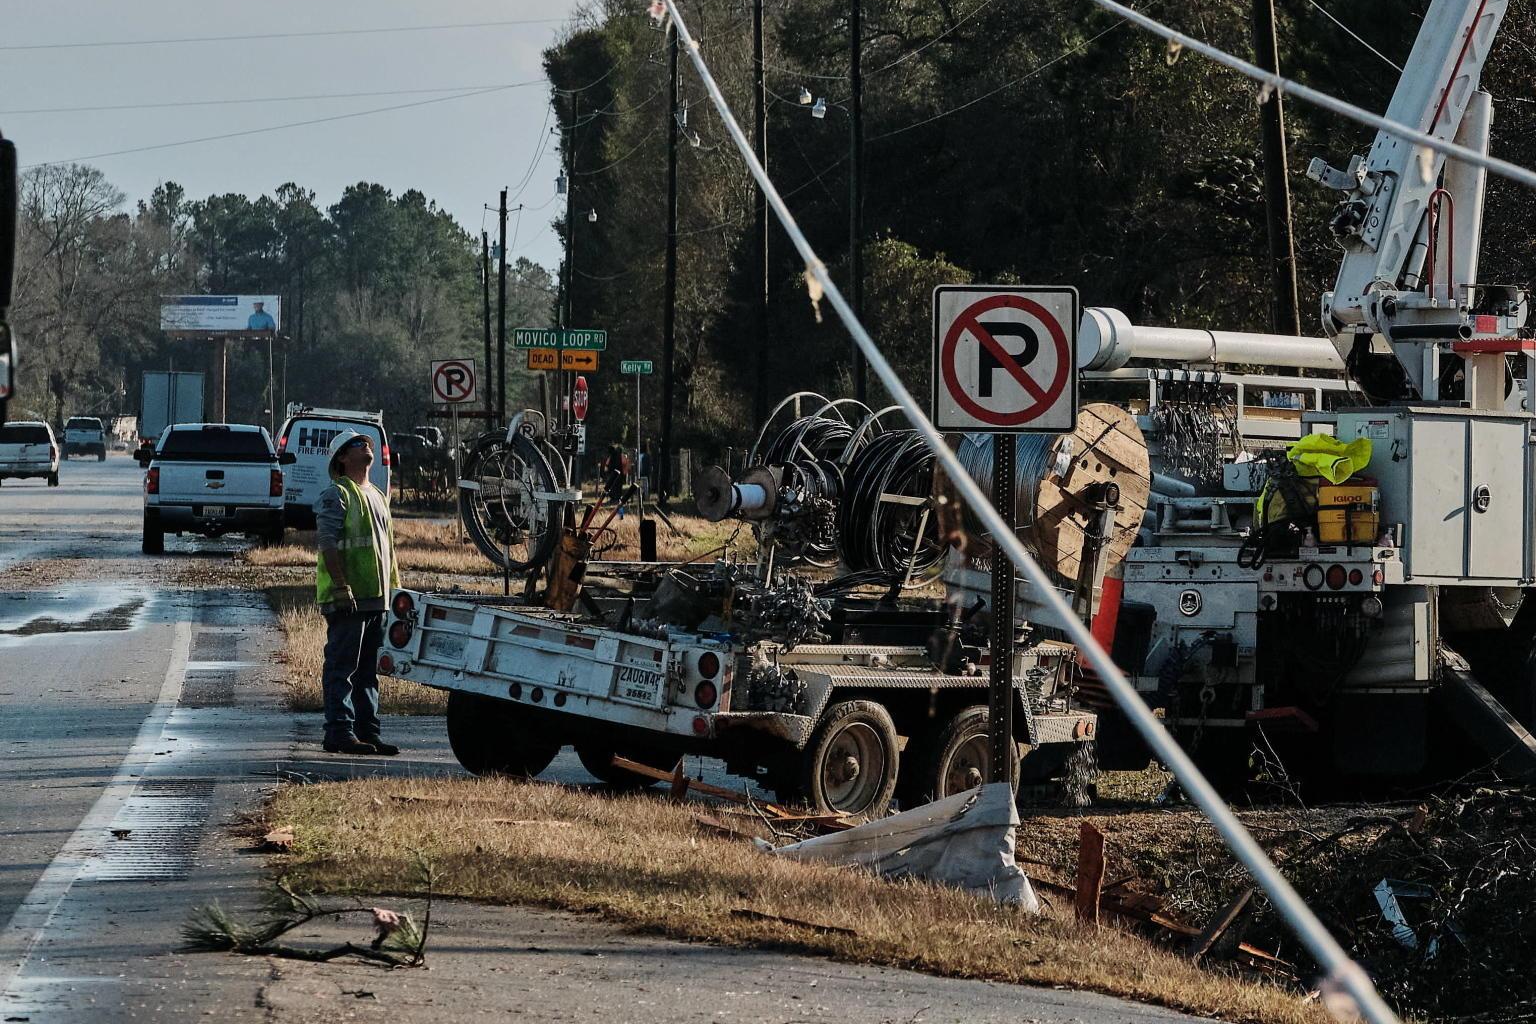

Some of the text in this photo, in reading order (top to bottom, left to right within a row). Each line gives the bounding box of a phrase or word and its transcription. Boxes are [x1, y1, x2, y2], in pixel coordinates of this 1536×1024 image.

[516, 331, 604, 347] MOVICO LOOP RD
[532, 354, 554, 364] DEAD
[979, 321, 1039, 397] P
[623, 363, 641, 373] Kelly
[574, 390, 588, 407] STOP
[297, 447, 314, 455] FIRE
[1333, 495, 1362, 503] IGLOO
